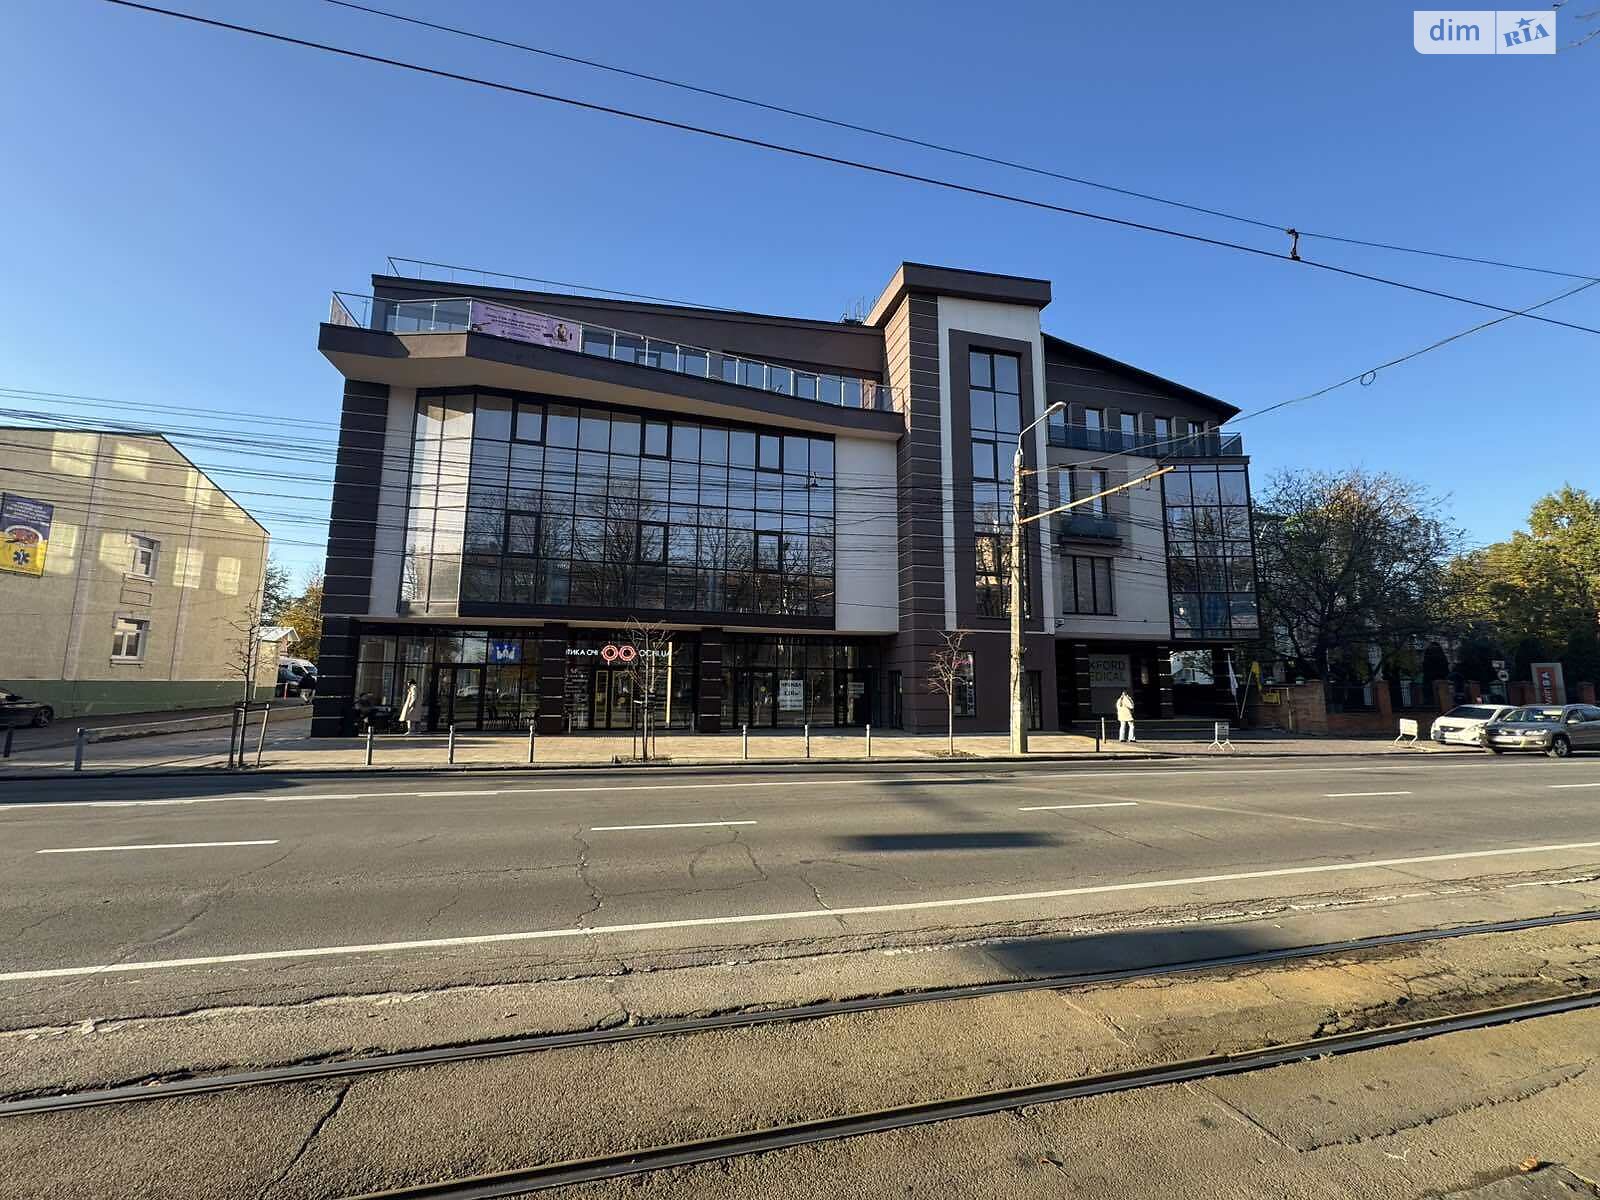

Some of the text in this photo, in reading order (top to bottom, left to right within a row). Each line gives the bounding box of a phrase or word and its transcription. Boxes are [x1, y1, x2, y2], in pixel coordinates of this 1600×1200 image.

[565, 648, 586, 656] ТИКА
[1088, 660, 1125, 671] XFORD
[1088, 671, 1128, 682] EDICAL
